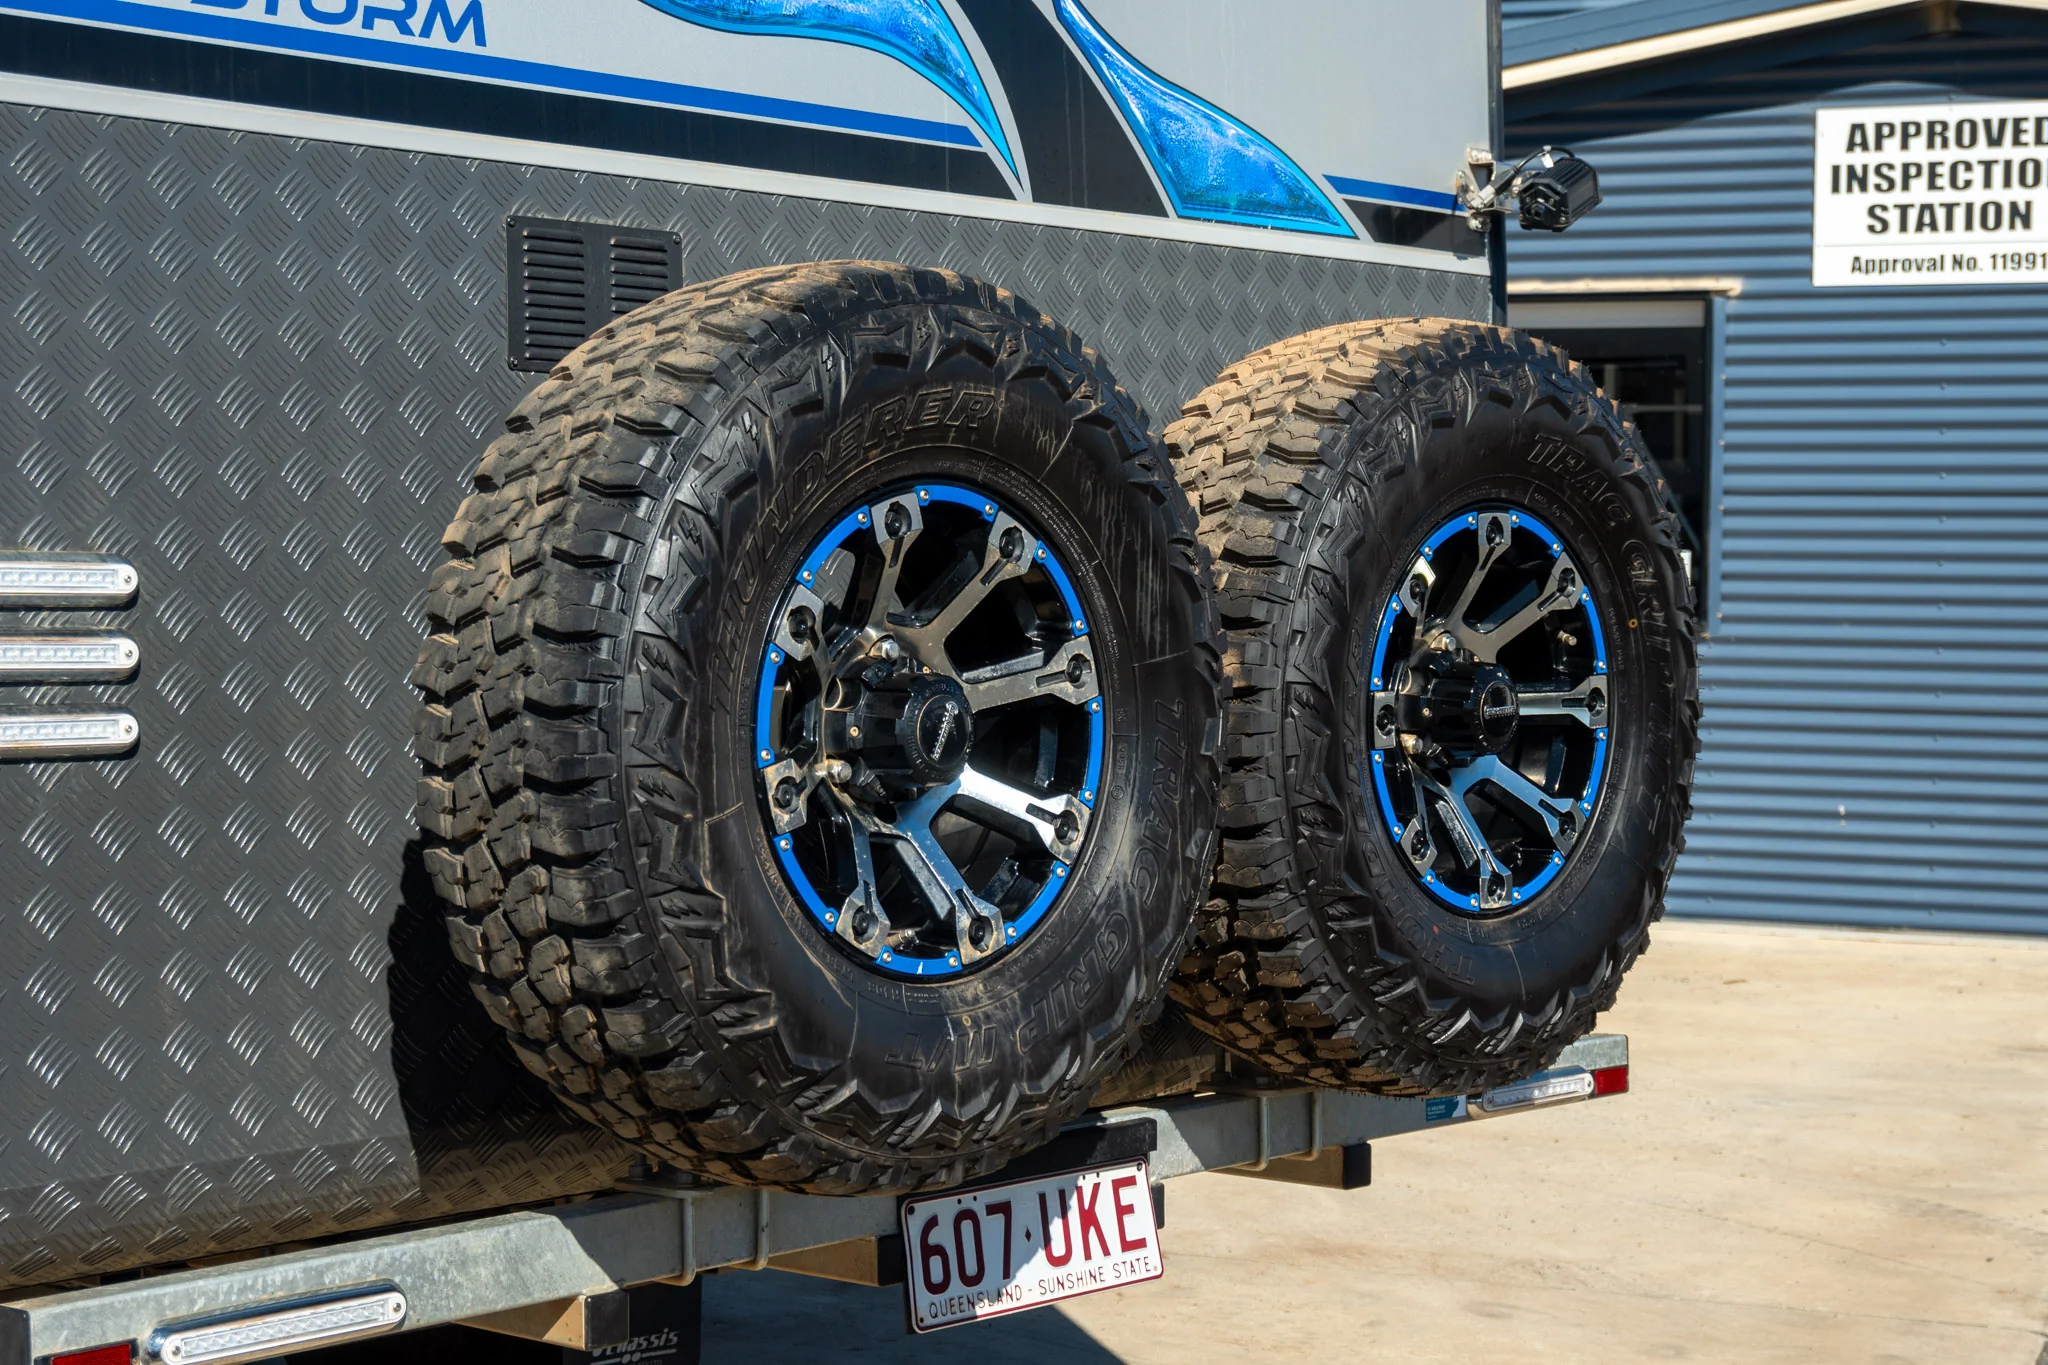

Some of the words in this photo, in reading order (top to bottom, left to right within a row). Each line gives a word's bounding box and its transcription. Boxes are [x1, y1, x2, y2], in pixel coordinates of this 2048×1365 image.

[190, 0, 487, 48] ORM
[1845, 115, 2048, 153] APPROVED
[1831, 157, 2048, 194] INSPECTIO
[1867, 200, 2032, 234] STATION
[1851, 254, 1945, 275] Approval
[1952, 253, 1983, 272] No.
[1990, 252, 2048, 271] 11991
[1527, 432, 1632, 527] TRAC
[708, 386, 996, 715] THUNDERER
[1130, 699, 1187, 907] TRAC
[1016, 908, 1131, 1054] GRIP
[886, 1023, 998, 1073] M/T
[920, 1200, 1013, 1296] 607
[1038, 1175, 1148, 1268] UKE
[929, 1287, 1023, 1319] QUEENSLAND
[1038, 1266, 1106, 1296] SUNSHINE
[1113, 1256, 1152, 1279] STATE
